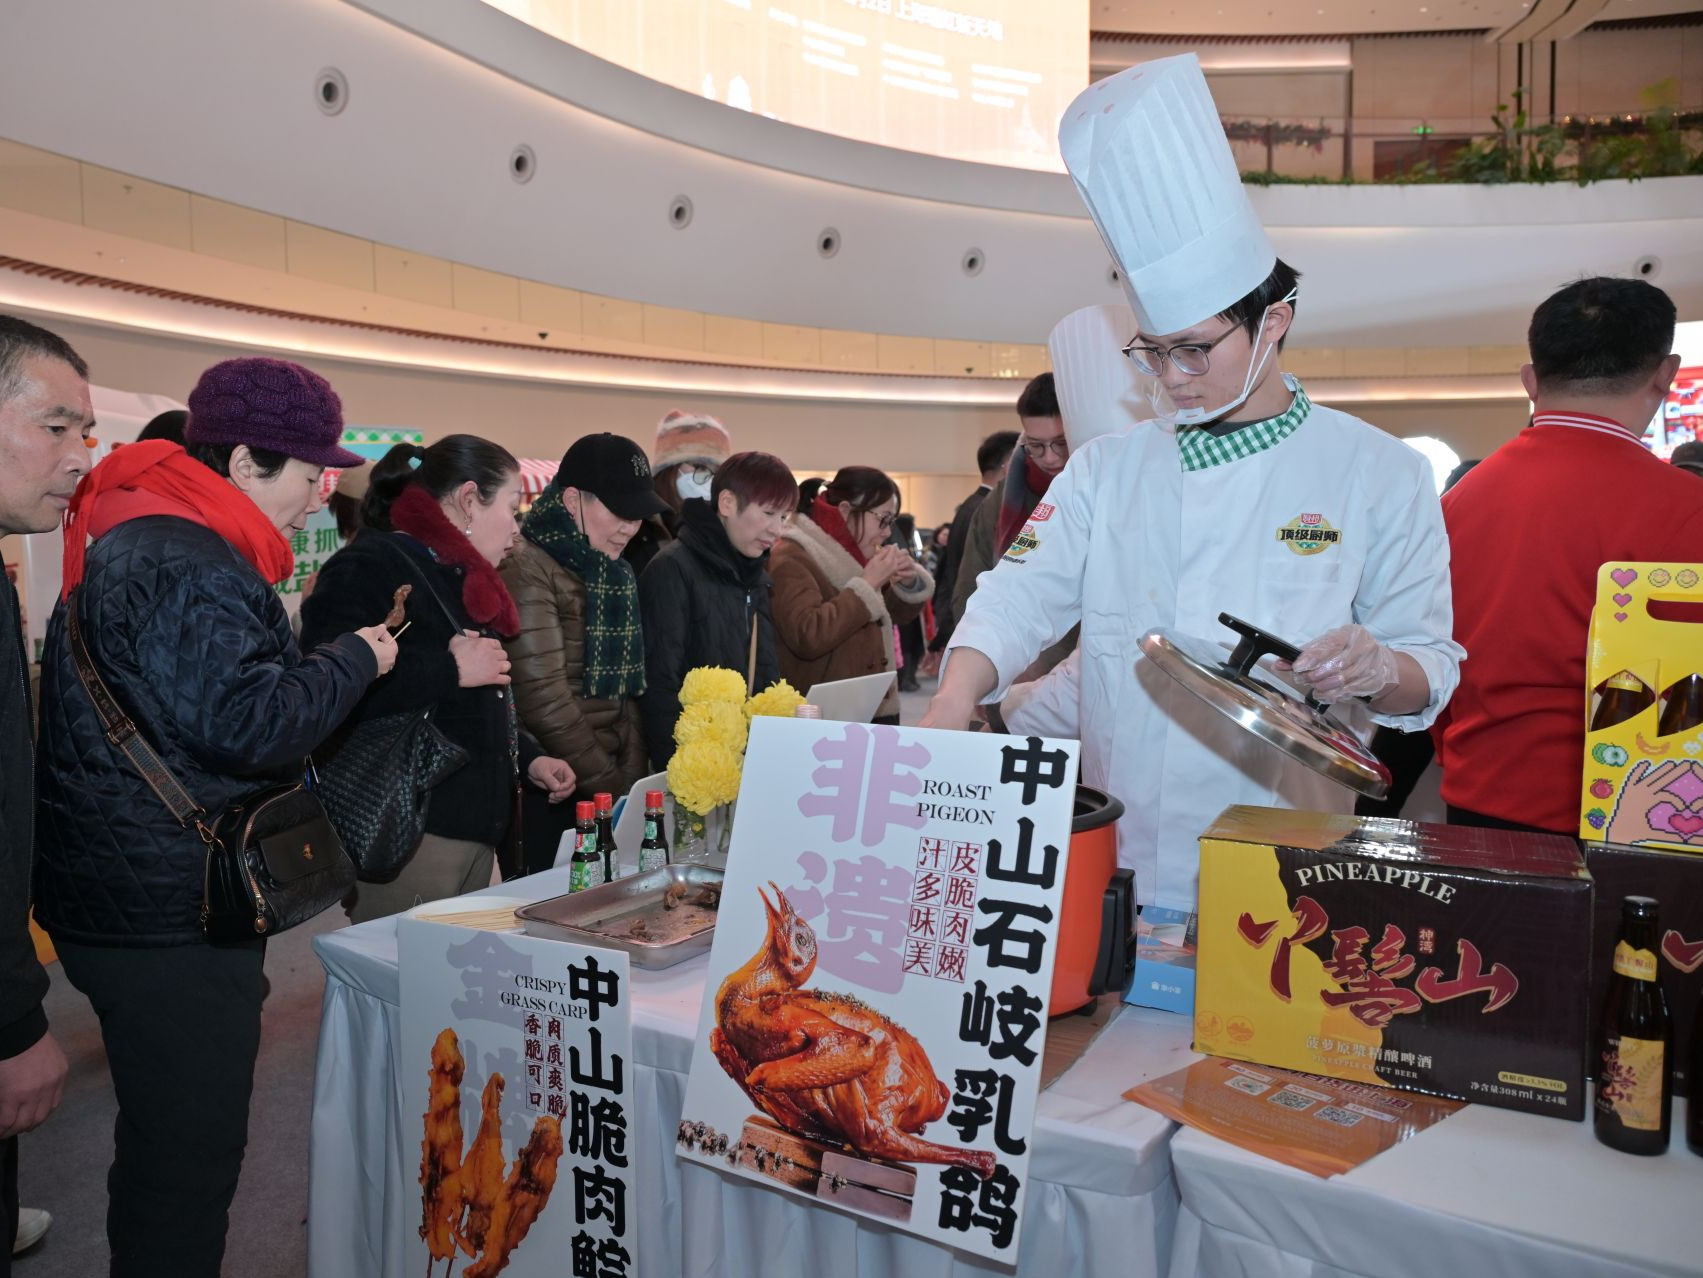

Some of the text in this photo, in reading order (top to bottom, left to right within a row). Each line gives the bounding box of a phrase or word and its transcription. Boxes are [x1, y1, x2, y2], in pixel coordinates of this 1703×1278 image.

[1280, 529, 1338, 542] 顶级厨师
[922, 778, 993, 801] ROAST
[916, 802, 996, 826] PIGEON
[1295, 862, 1457, 905] PINEAPPLE
[903, 837, 948, 976] 汁多味美
[935, 841, 981, 983] 皮脆肉嫩
[515, 974, 567, 996] CRISPY
[937, 736, 1070, 1249] 中山石岐乳鸽
[501, 991, 588, 1020] GRASS CARP
[524, 1013, 544, 1108] 香脆可口
[546, 1017, 566, 1117] 肉质爽脆
[1395, 1068, 1418, 1079] BEER
